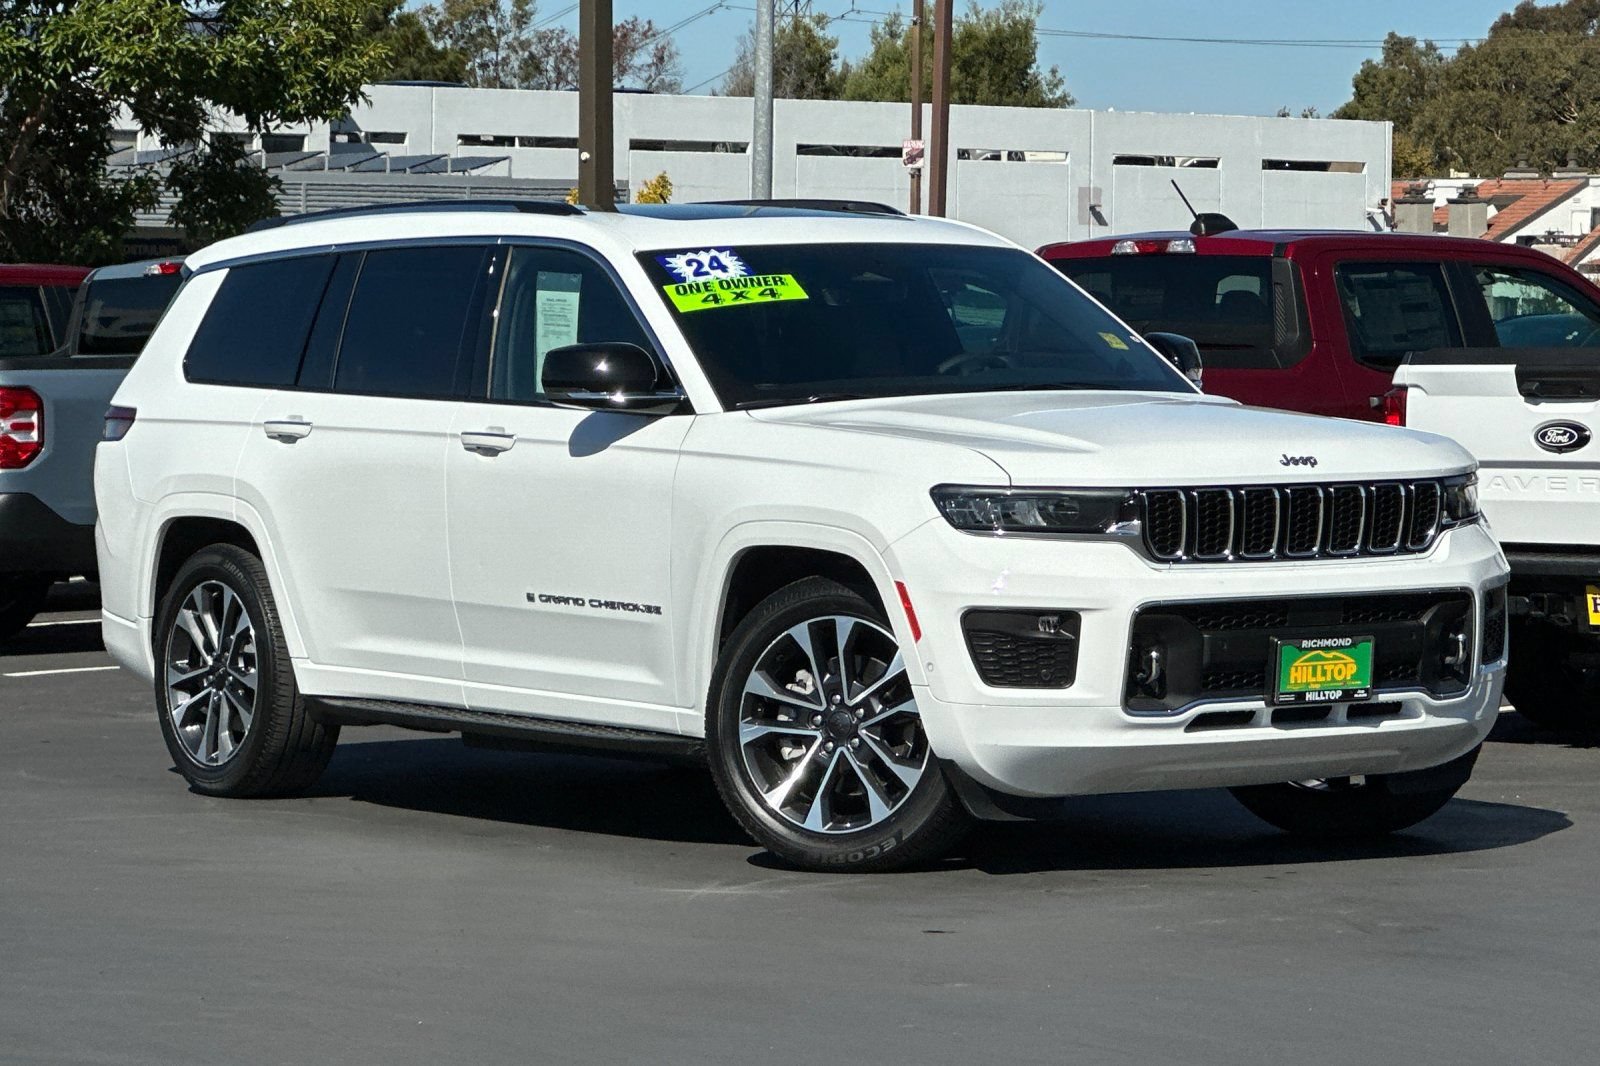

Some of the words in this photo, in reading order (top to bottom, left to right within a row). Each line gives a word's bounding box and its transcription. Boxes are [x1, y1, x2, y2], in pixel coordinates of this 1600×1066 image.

[685, 255, 730, 277] 24
[675, 280, 715, 296] ONE
[718, 276, 786, 291] OWNER
[1545, 429, 1570, 443] Ford
[1279, 453, 1318, 469] Jeep
[538, 593, 586, 607] GRAND
[588, 598, 662, 615] CHEROKEE
[1301, 637, 1352, 649] RICHMOND
[1290, 663, 1356, 683] HILLTOP
[1305, 690, 1343, 701] HILLTOP
